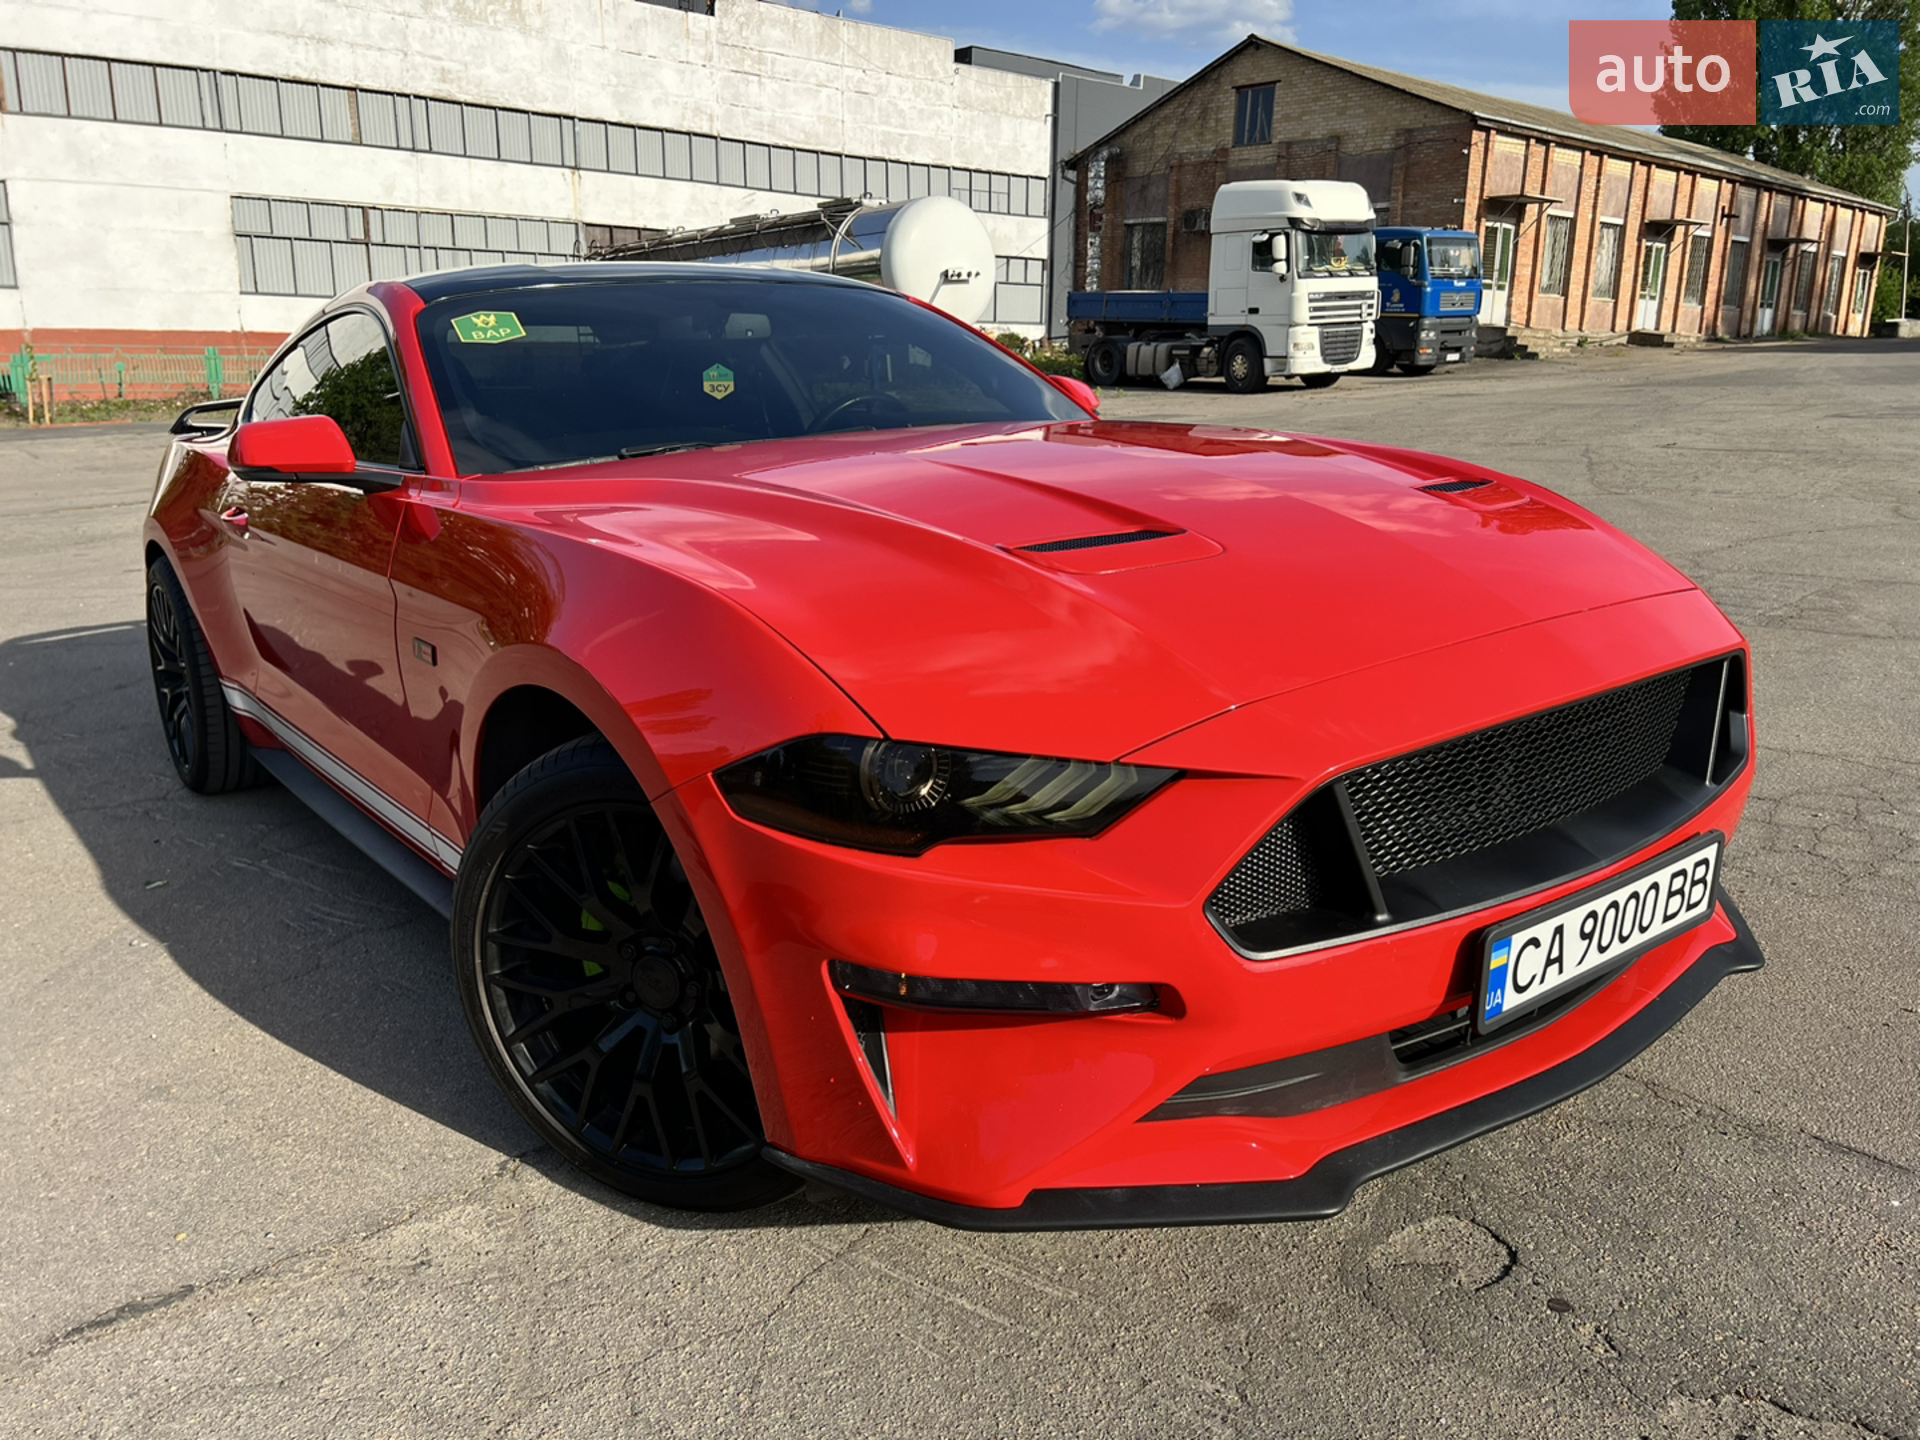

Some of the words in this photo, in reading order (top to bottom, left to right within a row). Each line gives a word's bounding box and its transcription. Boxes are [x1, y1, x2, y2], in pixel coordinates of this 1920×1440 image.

[1512, 923, 1565, 994] CA
[1576, 881, 1660, 968] 9000
[1661, 857, 1710, 925] BB
[1485, 988, 1503, 1010] UA
